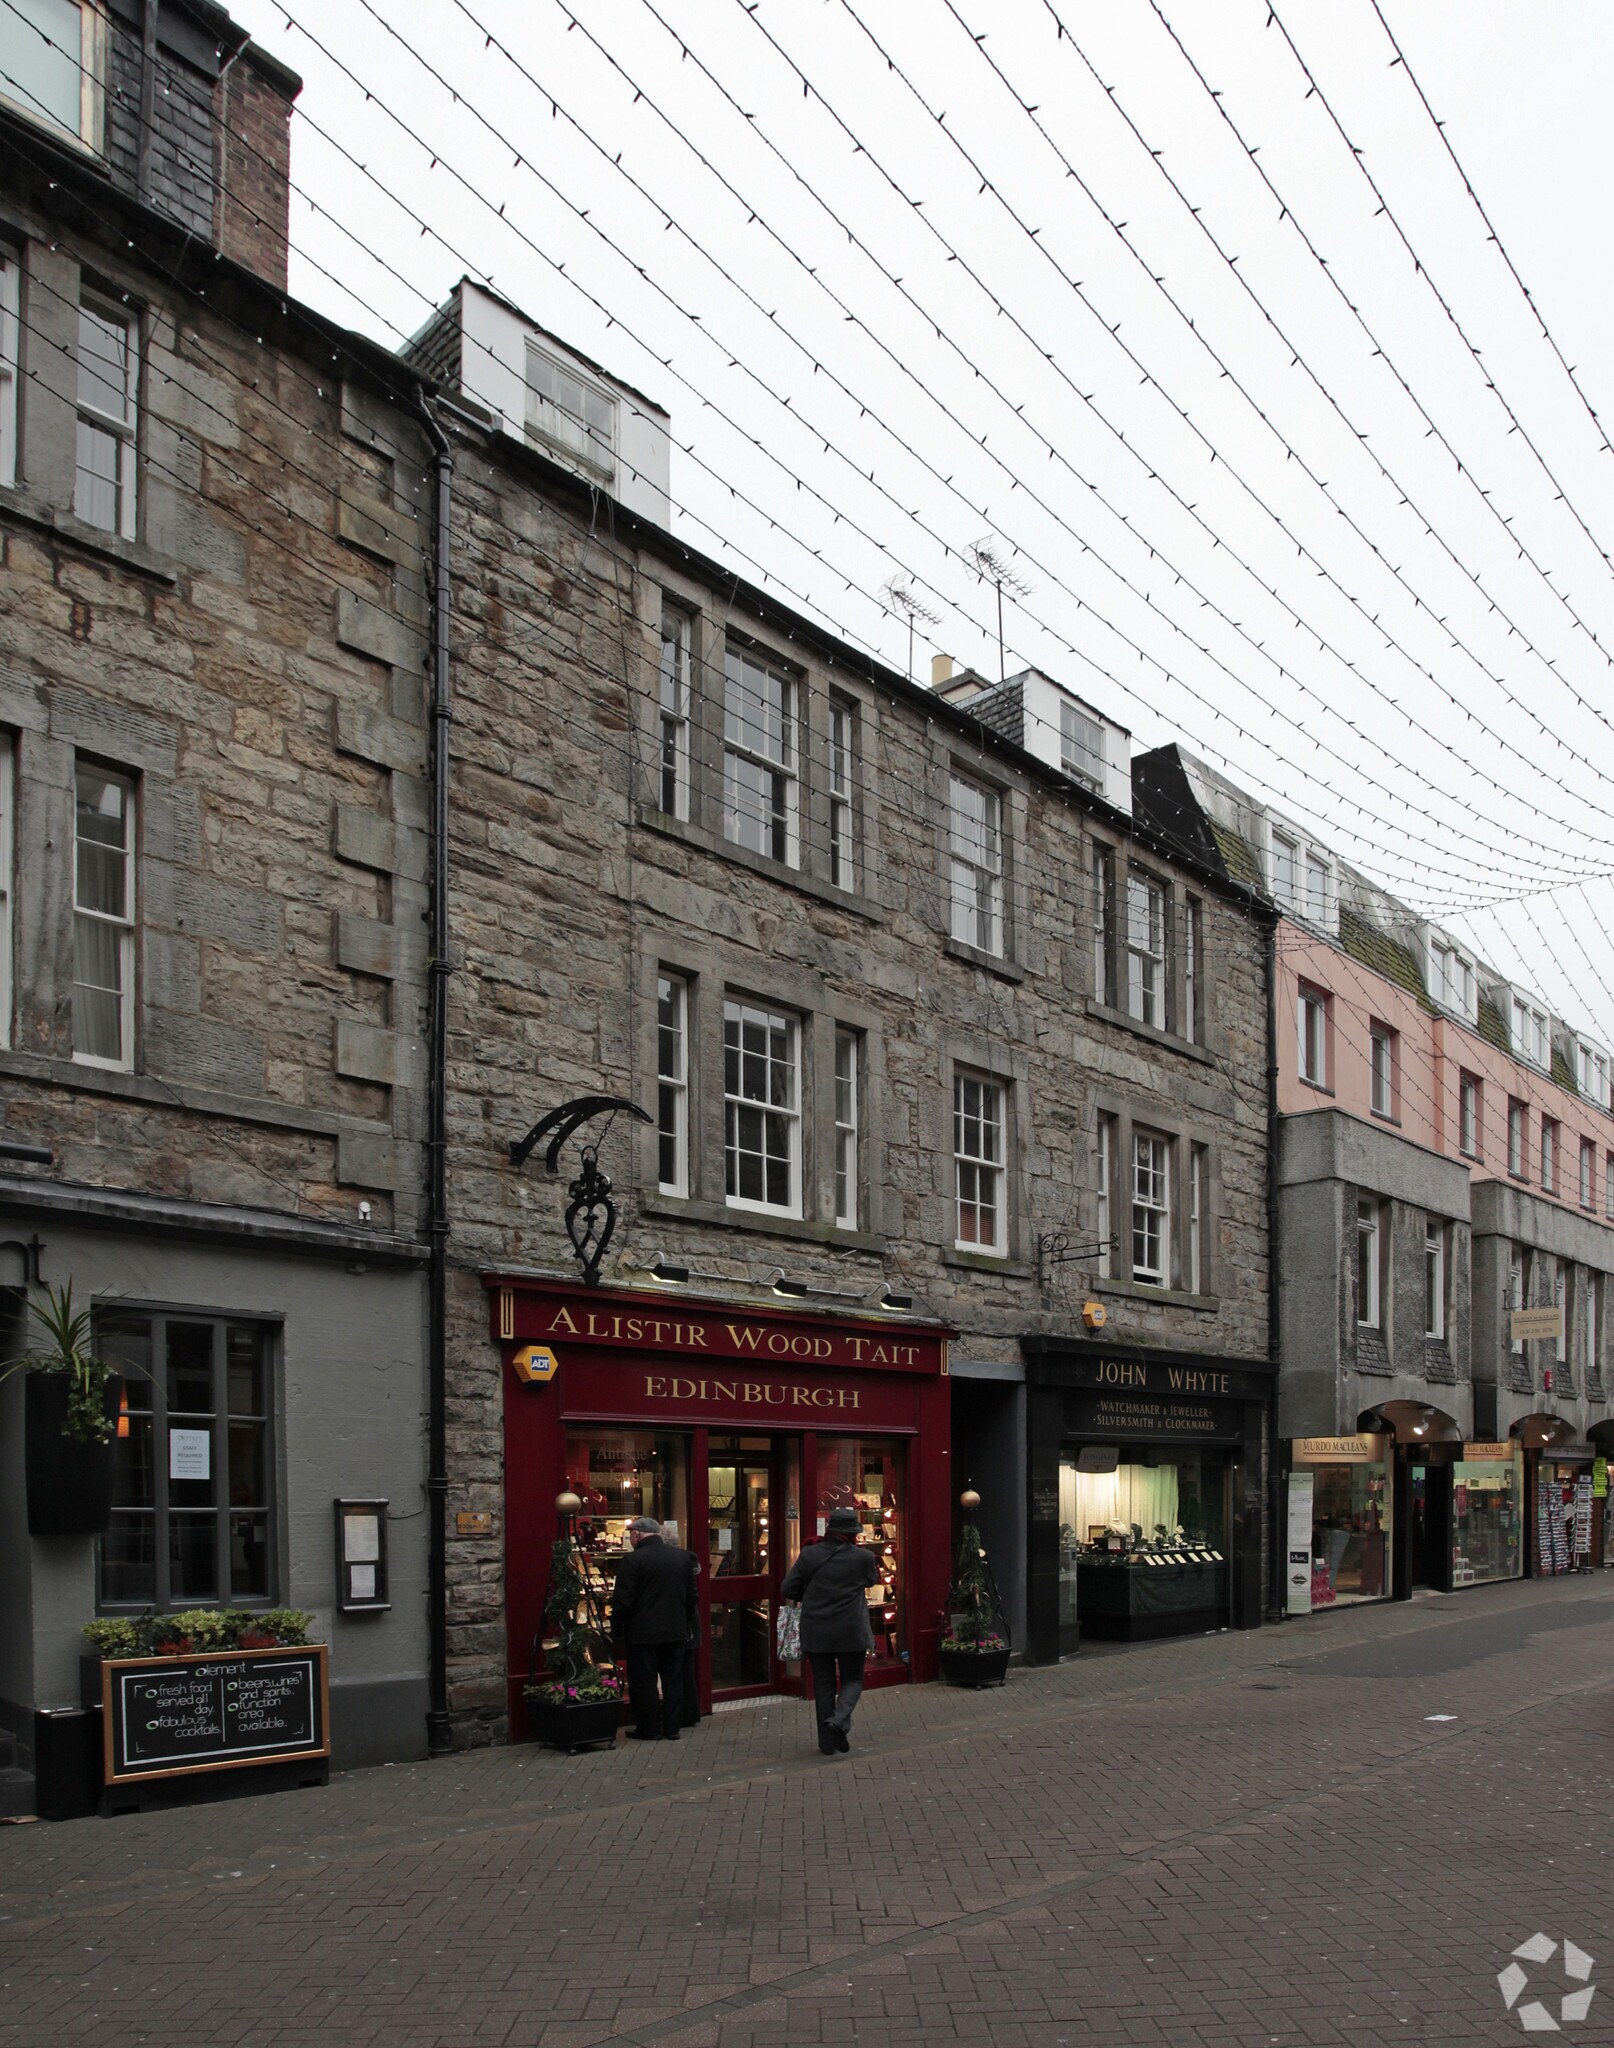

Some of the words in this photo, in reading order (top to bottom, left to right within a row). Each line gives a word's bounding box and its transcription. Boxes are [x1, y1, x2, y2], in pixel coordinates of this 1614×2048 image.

[546, 1306, 708, 1347] ALISTIR
[725, 1324, 832, 1358] WOOD
[845, 1337, 920, 1365] TAIT
[531, 1358, 549, 1369] ADT
[1096, 1360, 1146, 1386] JOHN
[1168, 1367, 1229, 1393] WHYTE
[644, 1376, 861, 1409] EDINBURGH
[1303, 1441, 1331, 1452] MURDO
[1333, 1442, 1367, 1453] MACLEANS
[158, 1683, 187, 1697] fresh
[190, 1680, 213, 1693] food
[239, 1689, 259, 1700] and
[156, 1693, 194, 1708] served
[195, 1692, 209, 1704] all
[238, 1698, 281, 1710] function
[158, 1714, 207, 1728] fabulous
[238, 1709, 264, 1720] area
